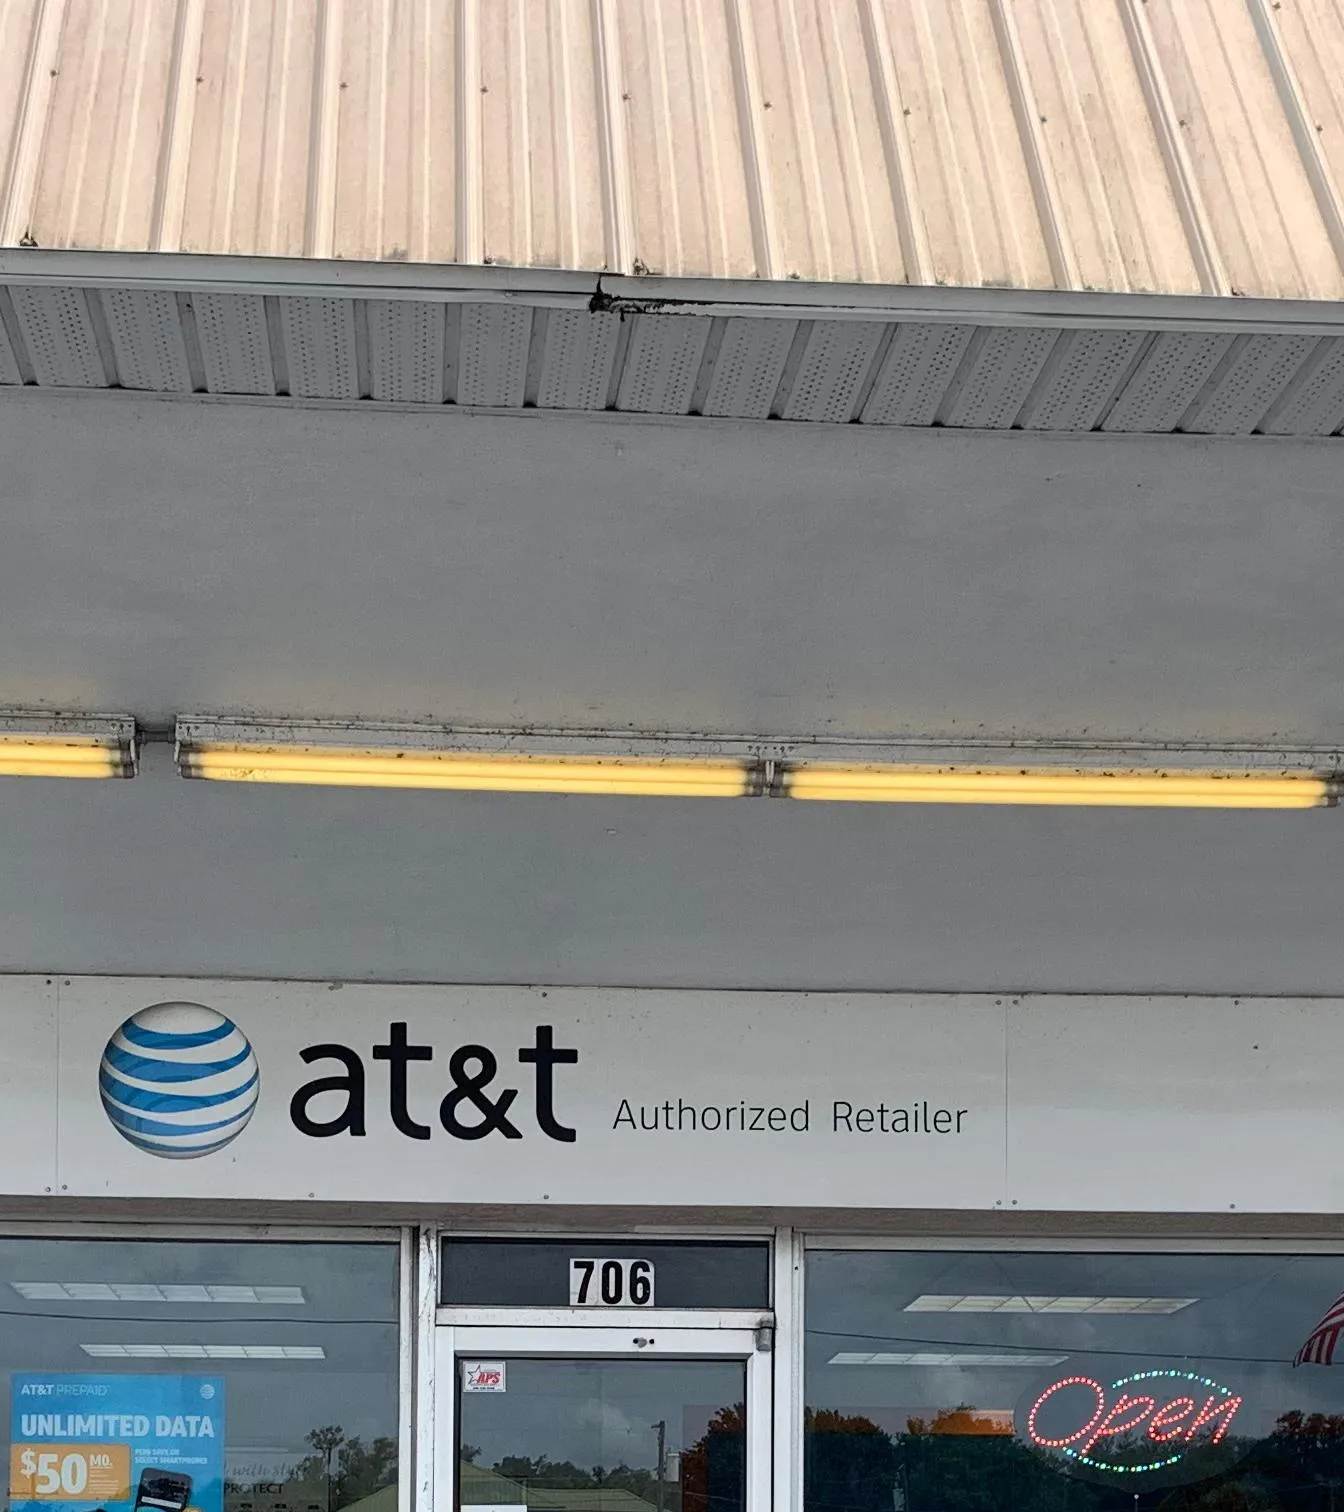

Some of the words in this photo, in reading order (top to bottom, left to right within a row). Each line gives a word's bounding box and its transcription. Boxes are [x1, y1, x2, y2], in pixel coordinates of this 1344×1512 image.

[289, 1021, 578, 1143] at&t
[612, 1098, 810, 1132] Authorized
[832, 1100, 968, 1134] Retailer
[573, 1260, 652, 1305] 706
[21, 1384, 54, 1396] AT&T
[56, 1384, 108, 1396] PREPAID
[21, 1414, 150, 1436] UNLIMITED
[156, 1415, 215, 1438] DATA
[1028, 1376, 1242, 1455] Open
[20, 1448, 88, 1495] $50
